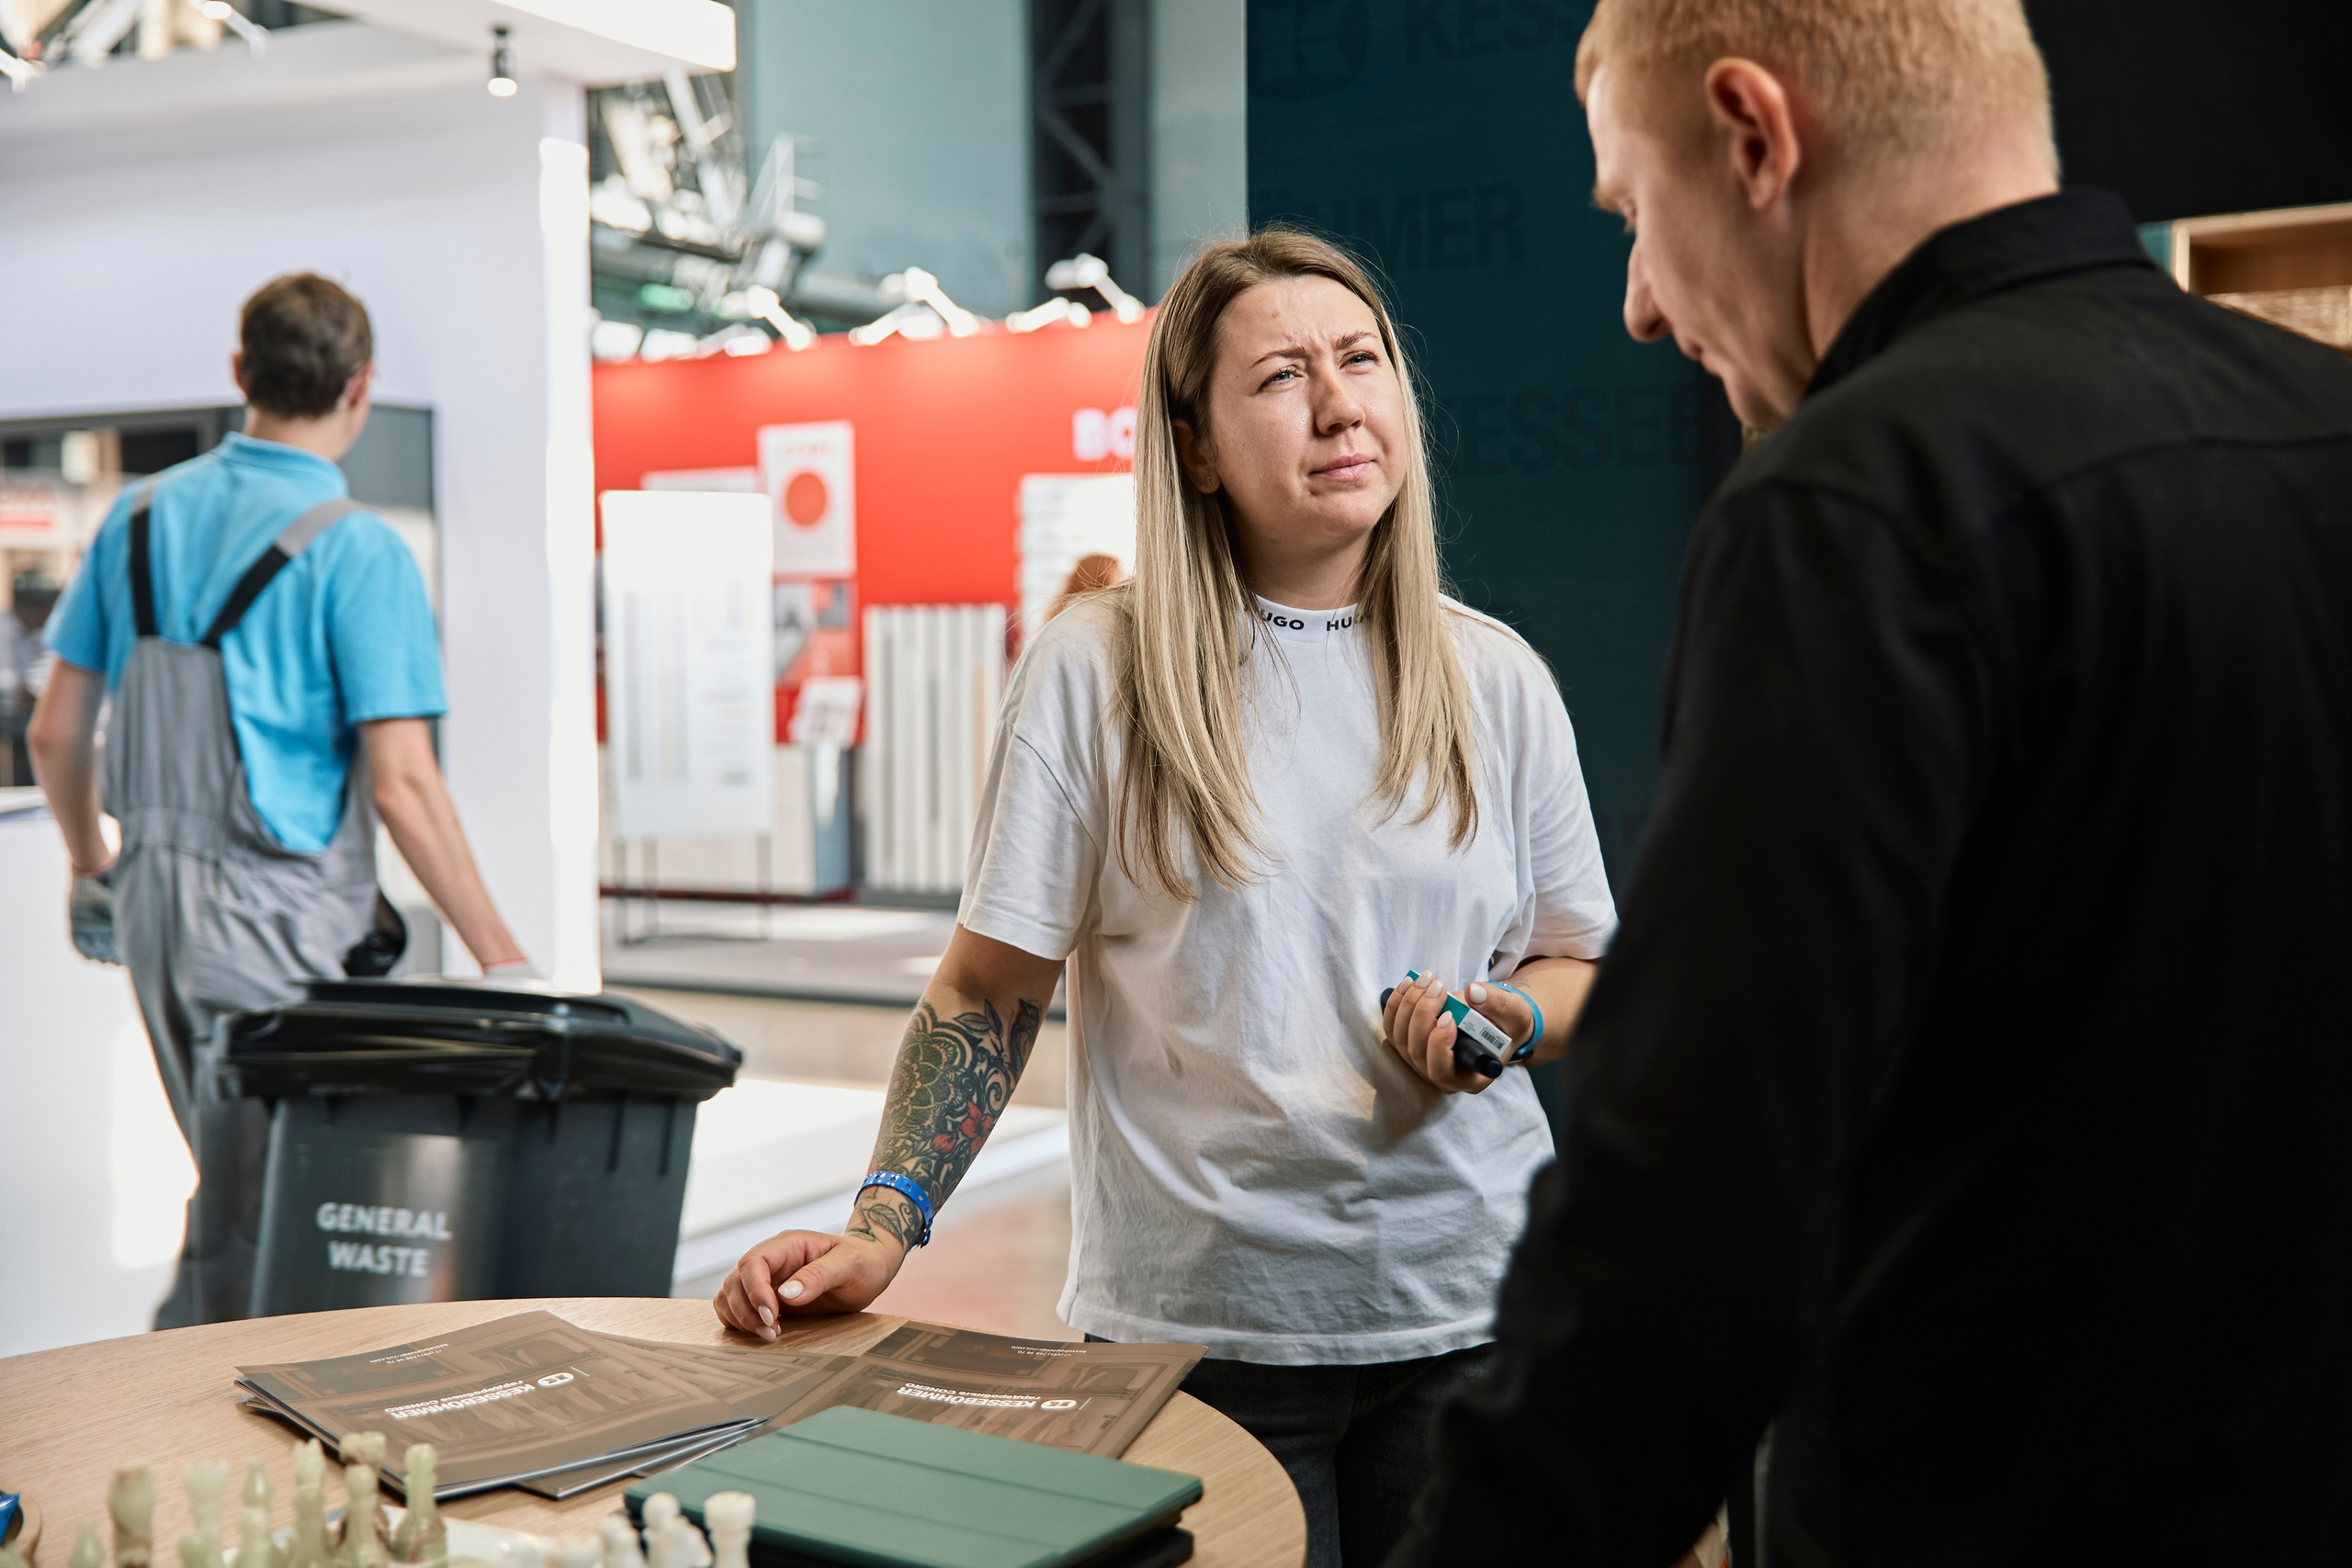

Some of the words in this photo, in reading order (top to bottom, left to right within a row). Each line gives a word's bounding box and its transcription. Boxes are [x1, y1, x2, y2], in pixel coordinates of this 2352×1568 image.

[1251, 182, 1526, 272] MER
[1439, 379, 1705, 476] ESSE
[1261, 611, 1305, 630] UGO
[316, 1201, 453, 1240] GENERAL
[328, 1241, 430, 1277] WASTE
[390, 1383, 536, 1419] KESSEBÖHMER
[897, 1386, 1036, 1408] KESSEBÖHMER
[905, 1382, 956, 1394] CONERO
[384, 1400, 439, 1413] CONERO
